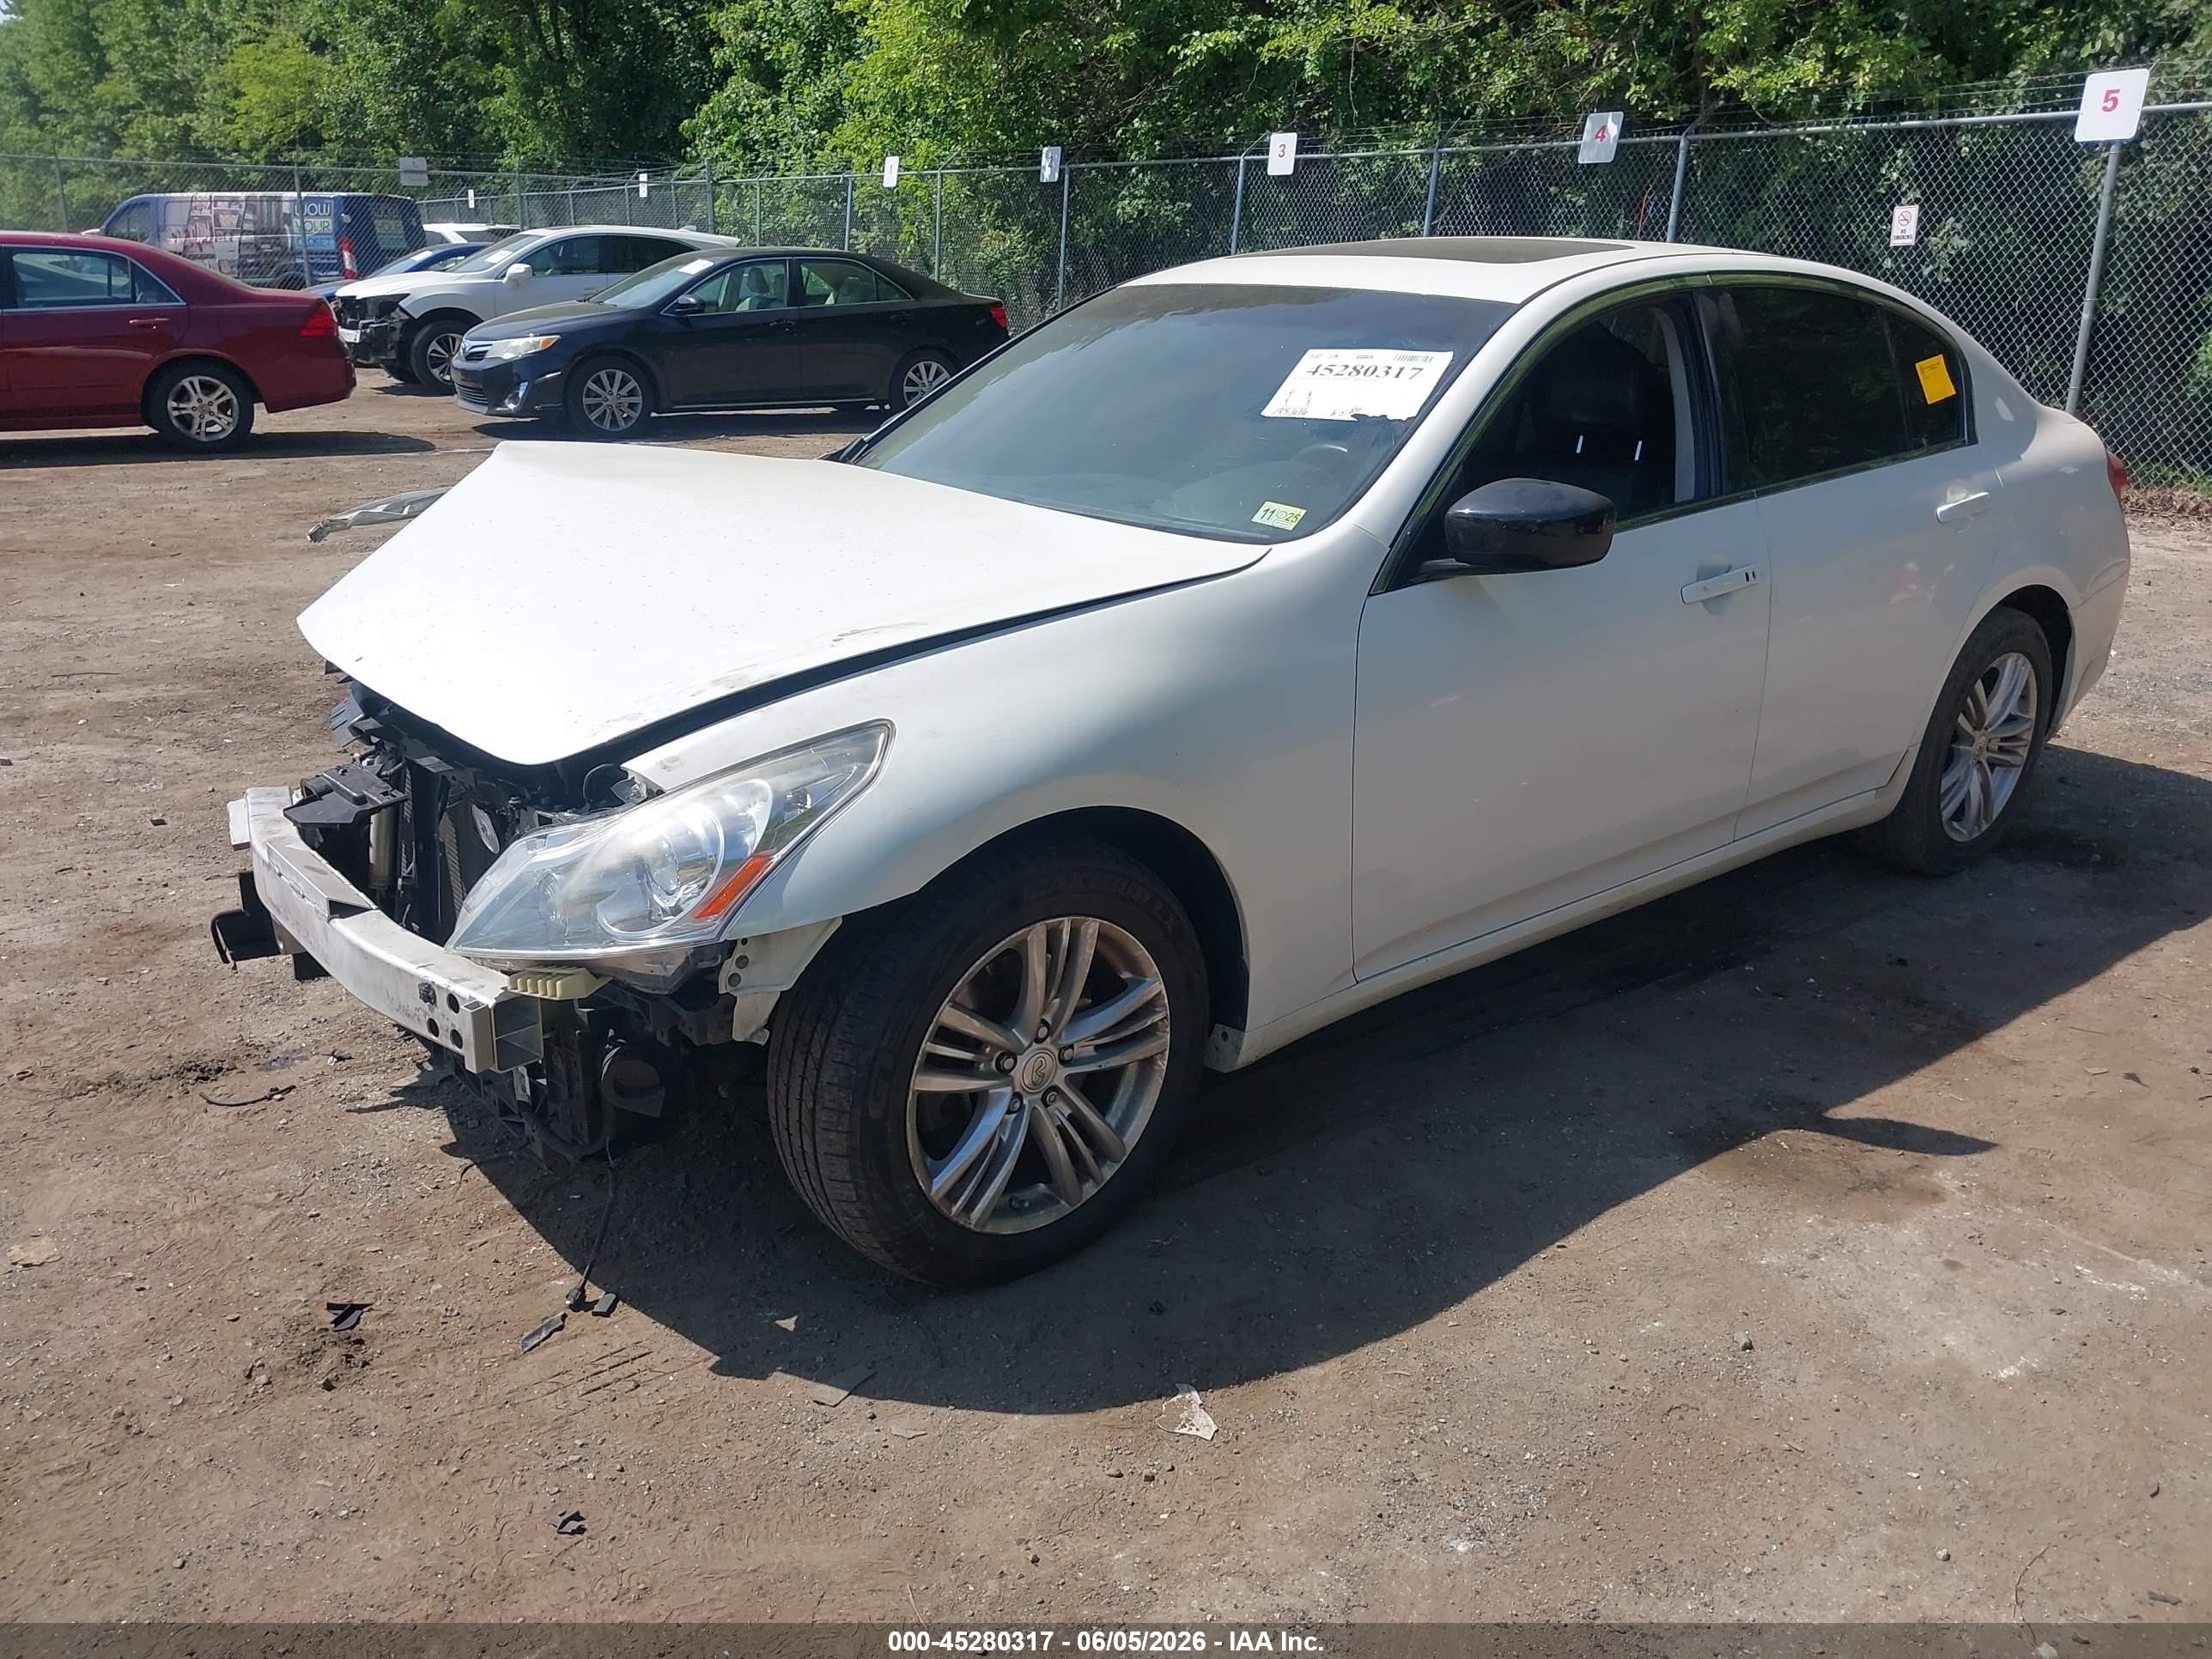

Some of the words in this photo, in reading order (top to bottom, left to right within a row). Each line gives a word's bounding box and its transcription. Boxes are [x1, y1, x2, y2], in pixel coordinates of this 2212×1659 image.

[2101, 88, 2121, 112] 5
[1595, 125, 1607, 143] 4
[1278, 143, 1286, 158] 3
[1306, 363, 1425, 380] 45280317
[1261, 507, 1277, 521] 11
